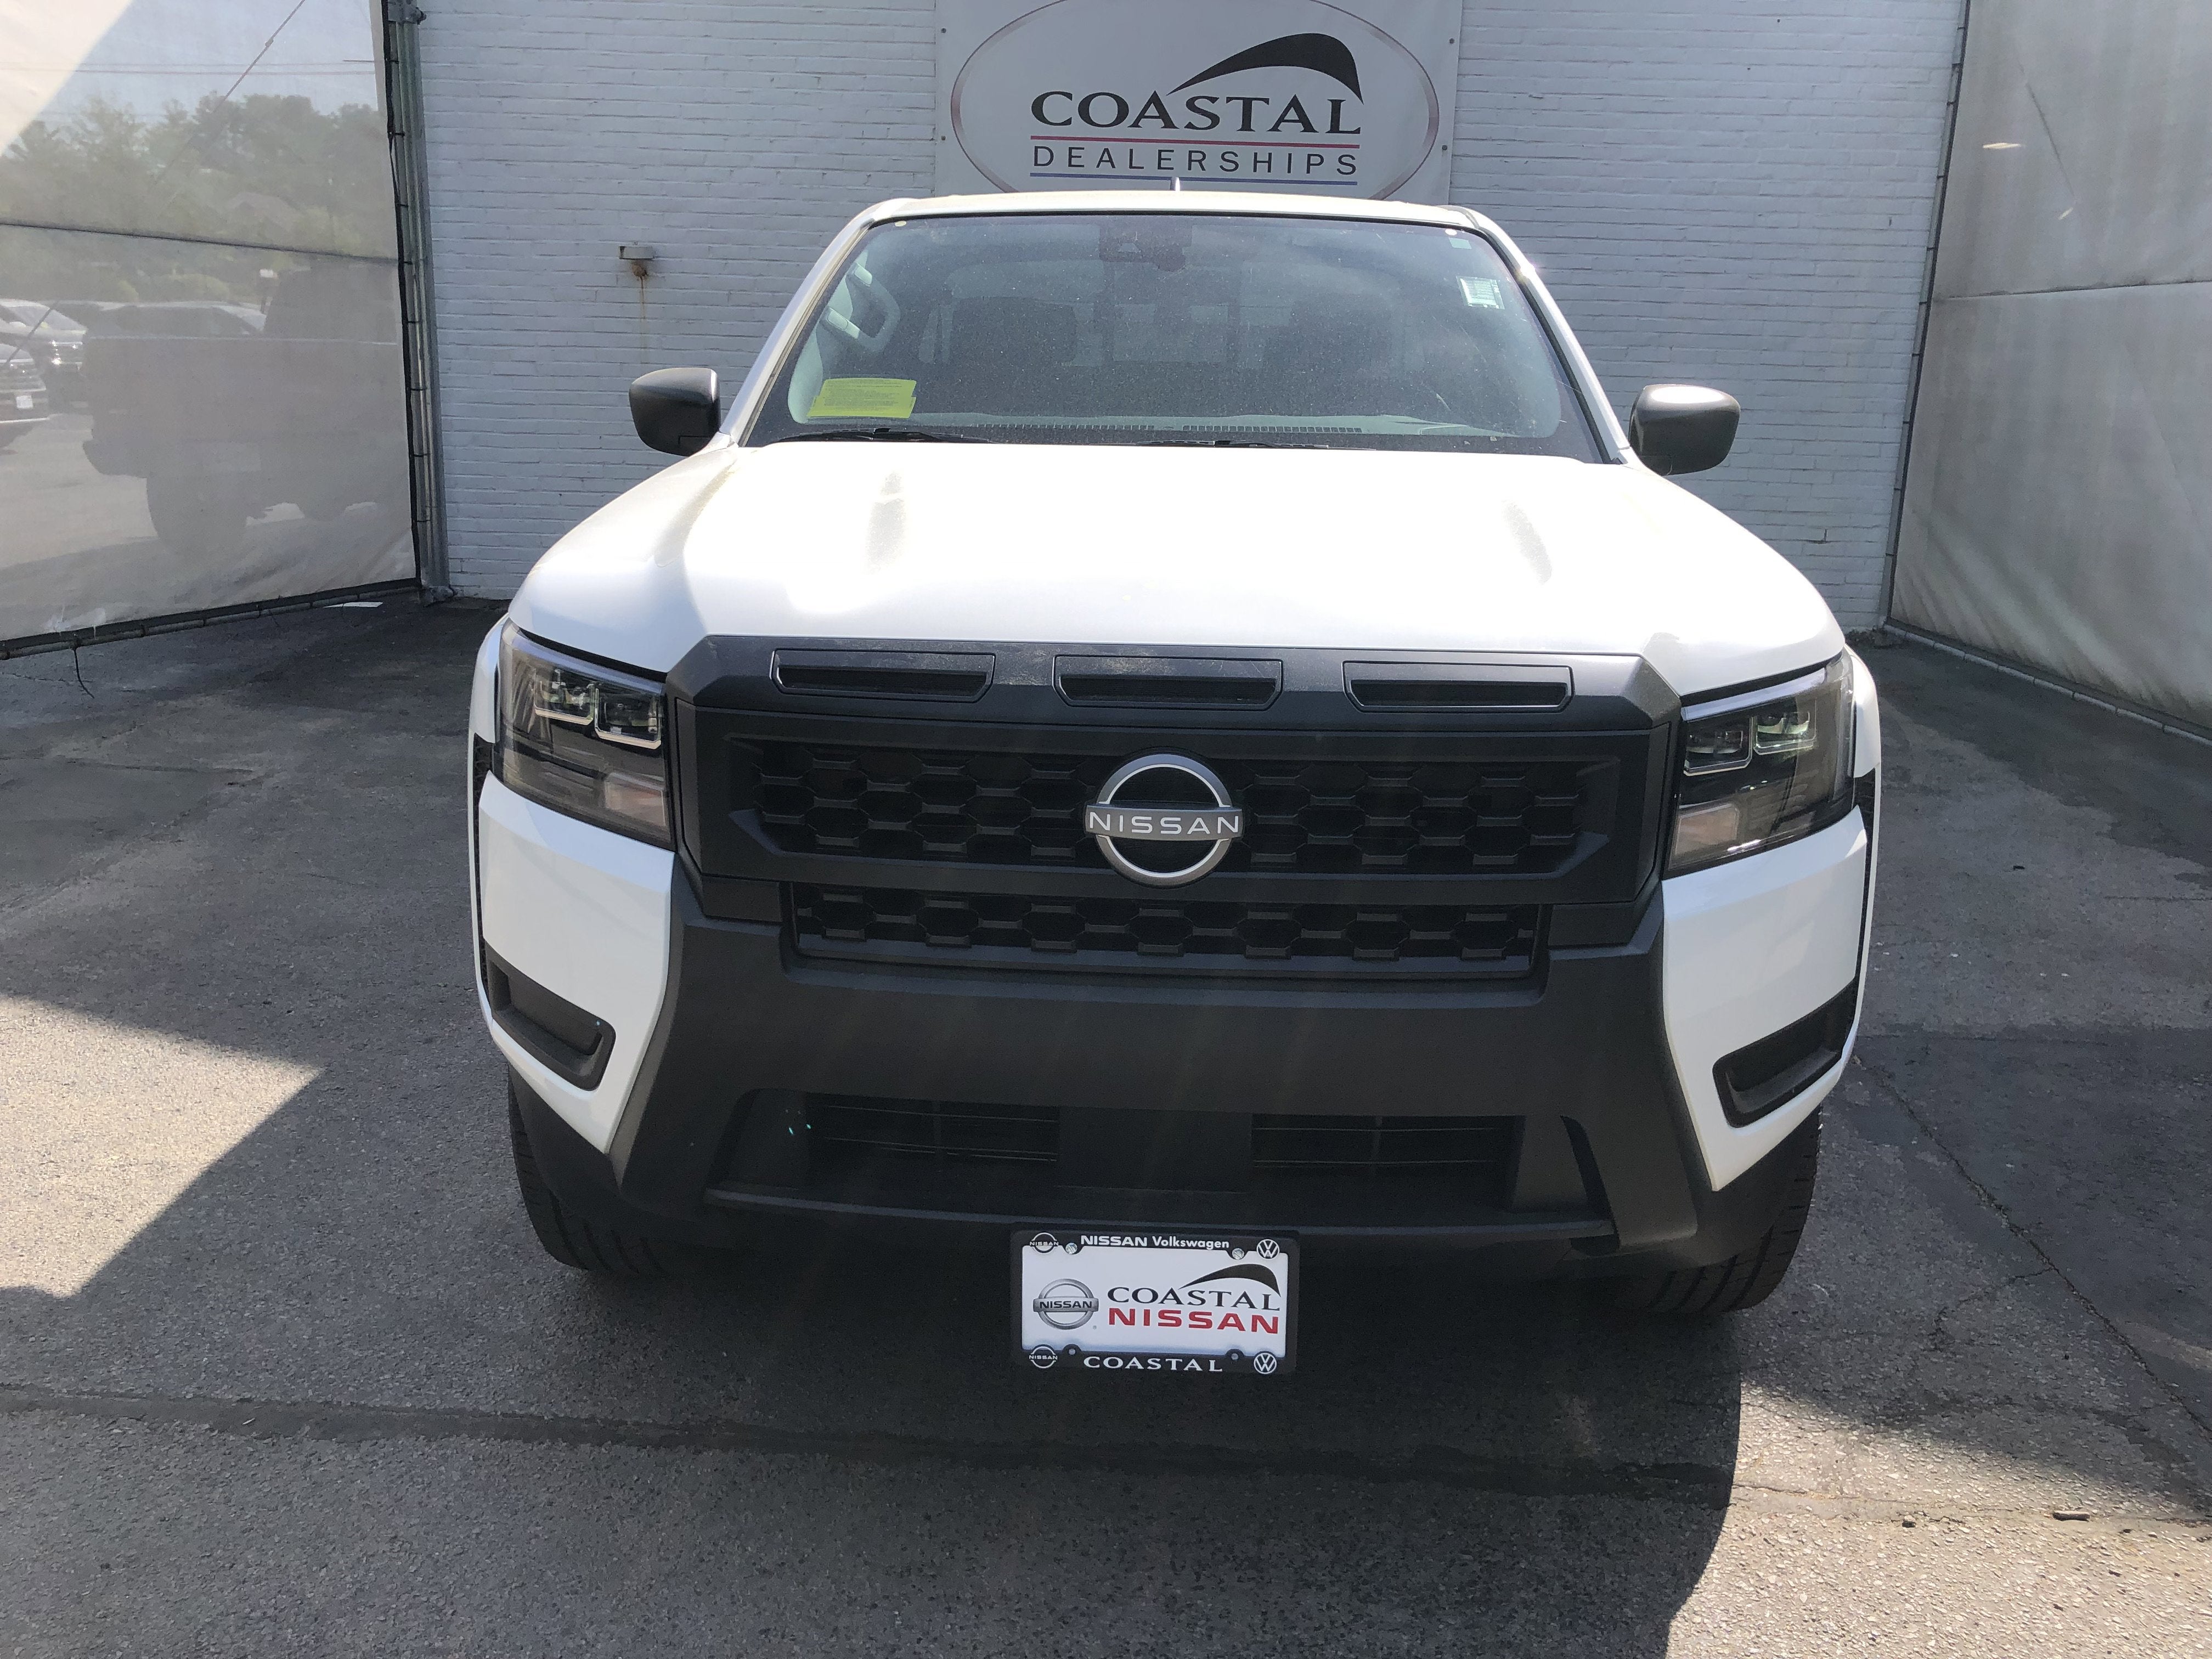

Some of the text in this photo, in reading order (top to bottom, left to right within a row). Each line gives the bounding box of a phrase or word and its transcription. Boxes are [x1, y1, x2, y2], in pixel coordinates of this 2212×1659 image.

[1030, 89, 1361, 134] COASTAL
[1034, 145, 1357, 175] DEALERSHIPS
[1089, 811, 1239, 834] NISSAN
[1080, 1235, 1229, 1250] NISSAN Volkswagen
[1040, 1300, 1093, 1310] NISSAN
[1107, 1286, 1280, 1312] COASTAL
[1108, 1307, 1279, 1335] NISSAN
[1083, 1356, 1223, 1372] COASTAL
